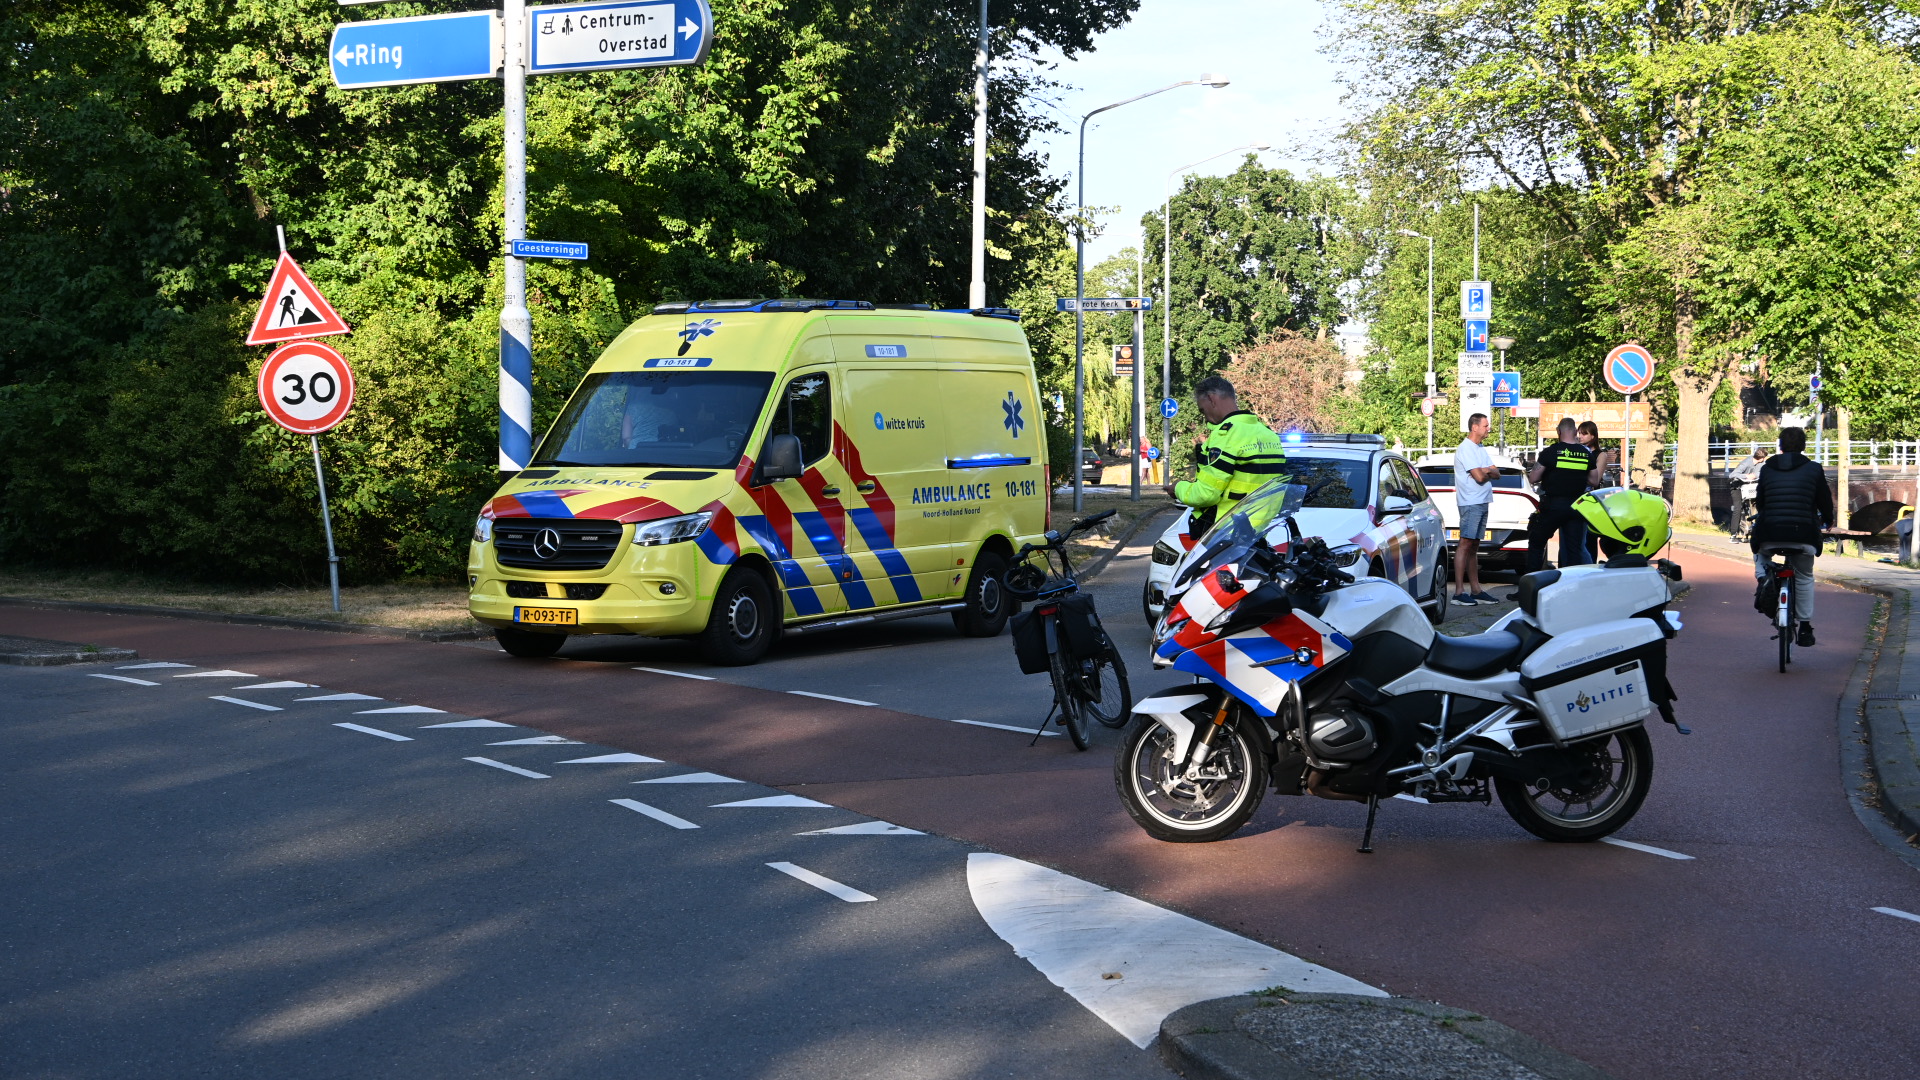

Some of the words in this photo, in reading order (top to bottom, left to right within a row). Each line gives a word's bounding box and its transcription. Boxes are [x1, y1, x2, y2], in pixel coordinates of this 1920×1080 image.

[580, 13, 654, 29] Centrum-
[599, 34, 667, 53] Overstad
[355, 43, 402, 69] Ring
[518, 243, 583, 256] Geestersingel
[1471, 290, 1480, 303] P
[1101, 300, 1119, 308] Kerk
[282, 371, 336, 405] 30
[886, 418, 905, 430] witte
[907, 417, 925, 429] kruis
[524, 479, 652, 489] AMBULANCE
[912, 483, 991, 504] AMBULANCE
[1005, 480, 1036, 497] 10-181
[923, 508, 963, 518] Noord-Holland
[964, 507, 980, 515] Noord
[523, 609, 572, 622] R-093-TF
[1594, 646, 1620, 657] dienstbaar
[1567, 683, 1634, 713] POLITIE
